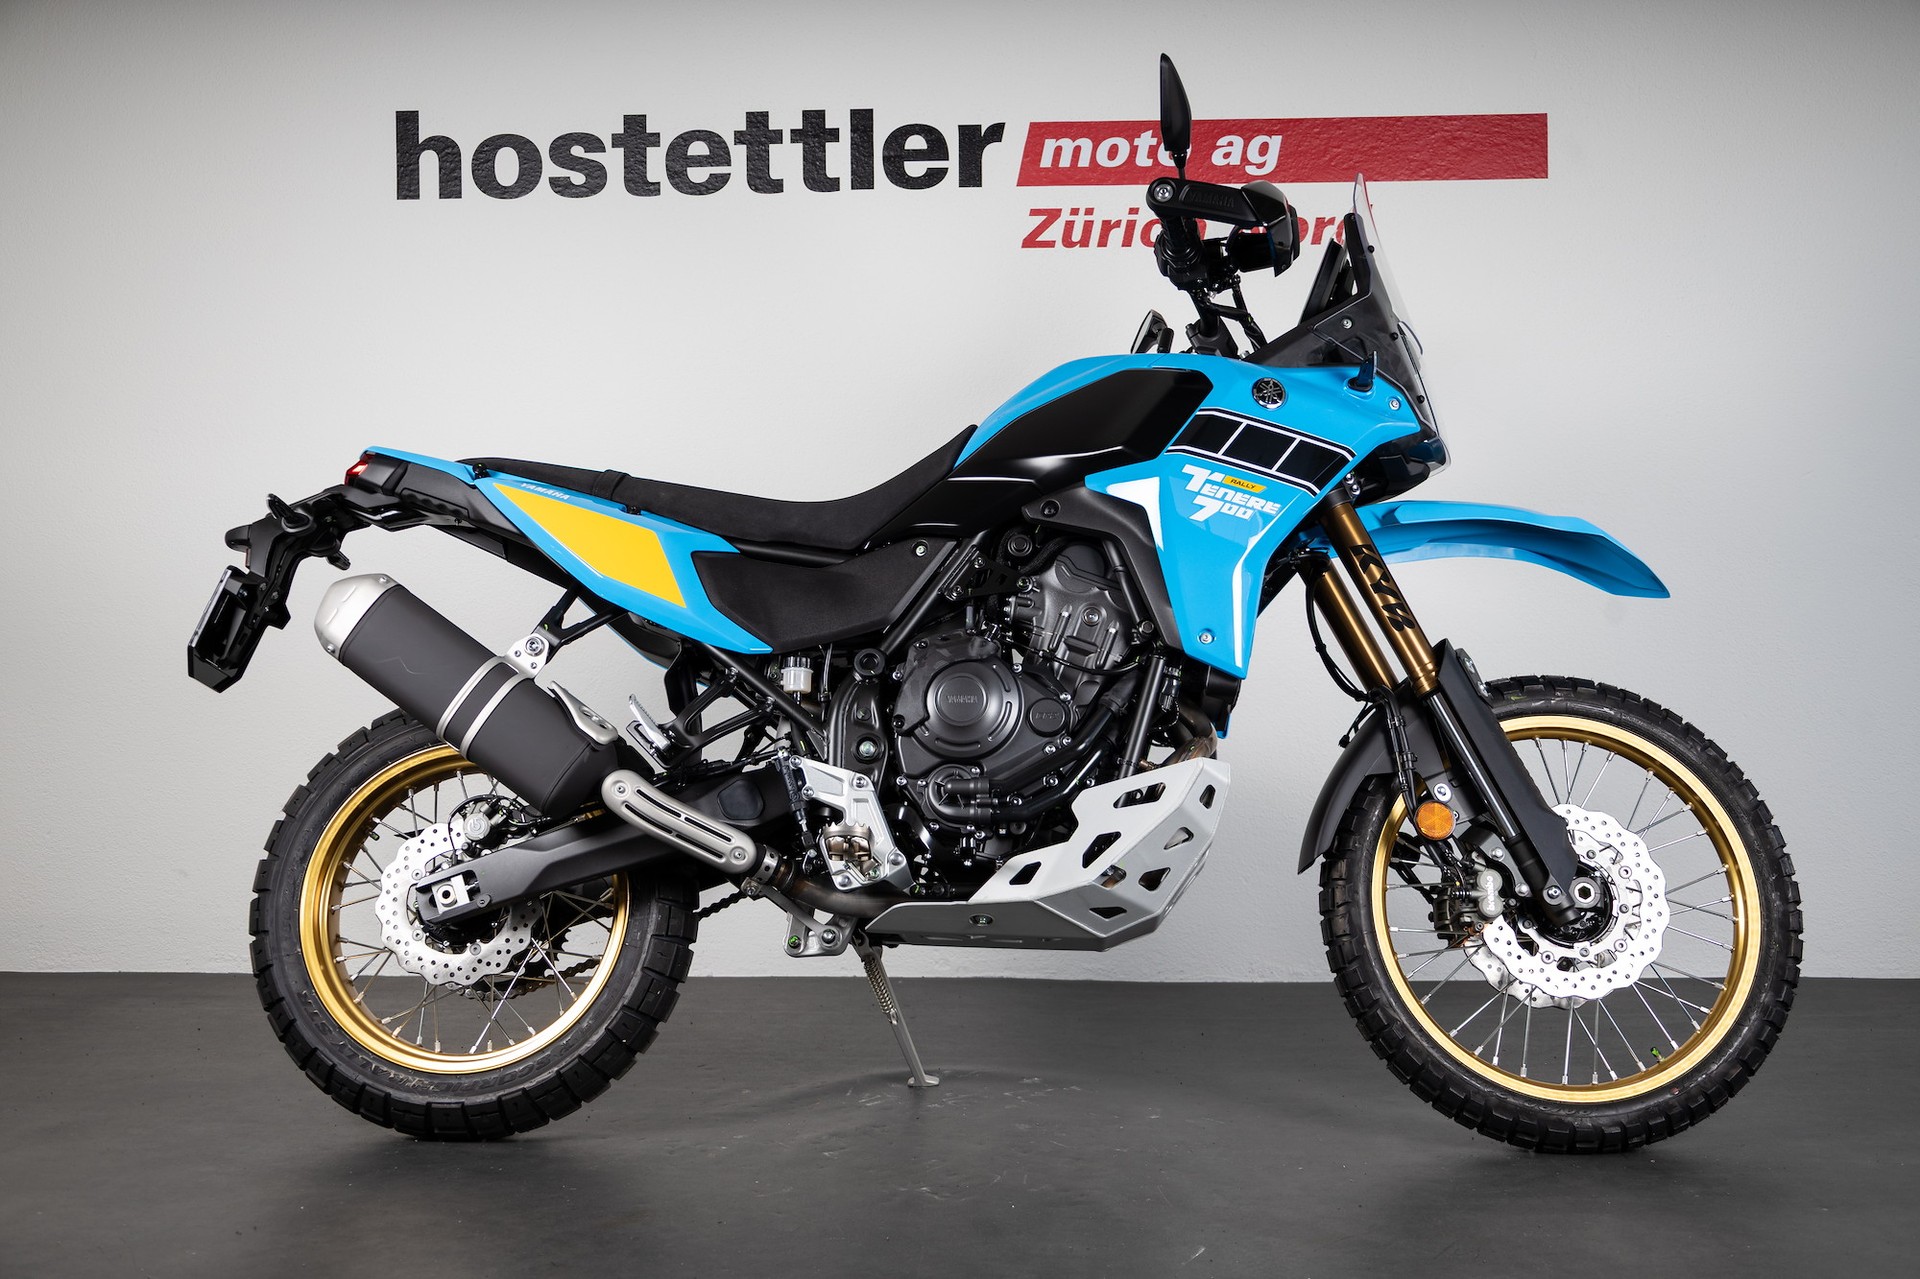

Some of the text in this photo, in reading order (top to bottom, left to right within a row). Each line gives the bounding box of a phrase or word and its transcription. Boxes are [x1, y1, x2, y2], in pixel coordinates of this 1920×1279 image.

[395, 108, 1005, 200] hostettler
[1211, 133, 1283, 176] ag
[1021, 207, 1207, 248] Züric
[520, 482, 571, 500] YAMAHA
[1230, 478, 1256, 490] RALLY
[1188, 494, 1255, 522] 700
[1350, 544, 1416, 632] KYB
[1485, 875, 1496, 911] brembo
